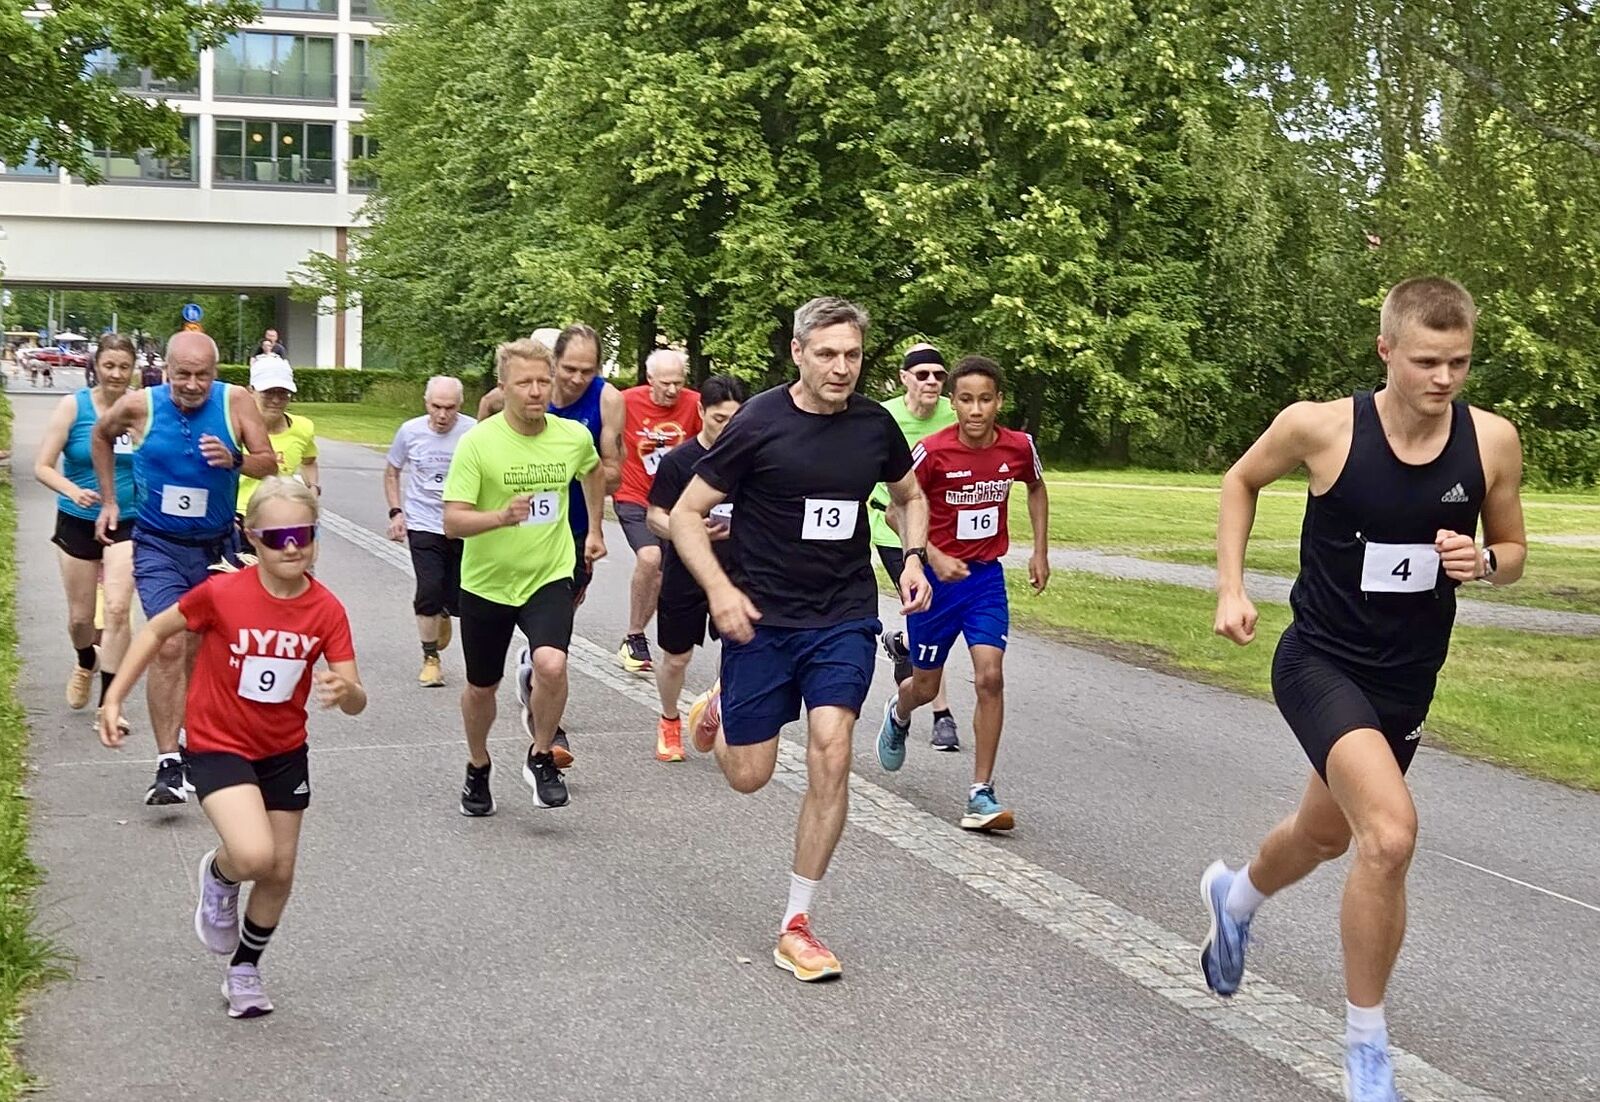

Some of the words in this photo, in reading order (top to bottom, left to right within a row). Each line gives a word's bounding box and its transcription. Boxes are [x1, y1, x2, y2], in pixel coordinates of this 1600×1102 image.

[435, 473, 443, 483] 5
[178, 495, 190, 510] 3
[530, 499, 550, 516] 15
[813, 507, 841, 528] 13
[970, 514, 991, 531] 16
[1391, 558, 1412, 581] 4
[229, 628, 320, 658] JYRY
[258, 670, 275, 692] 9
